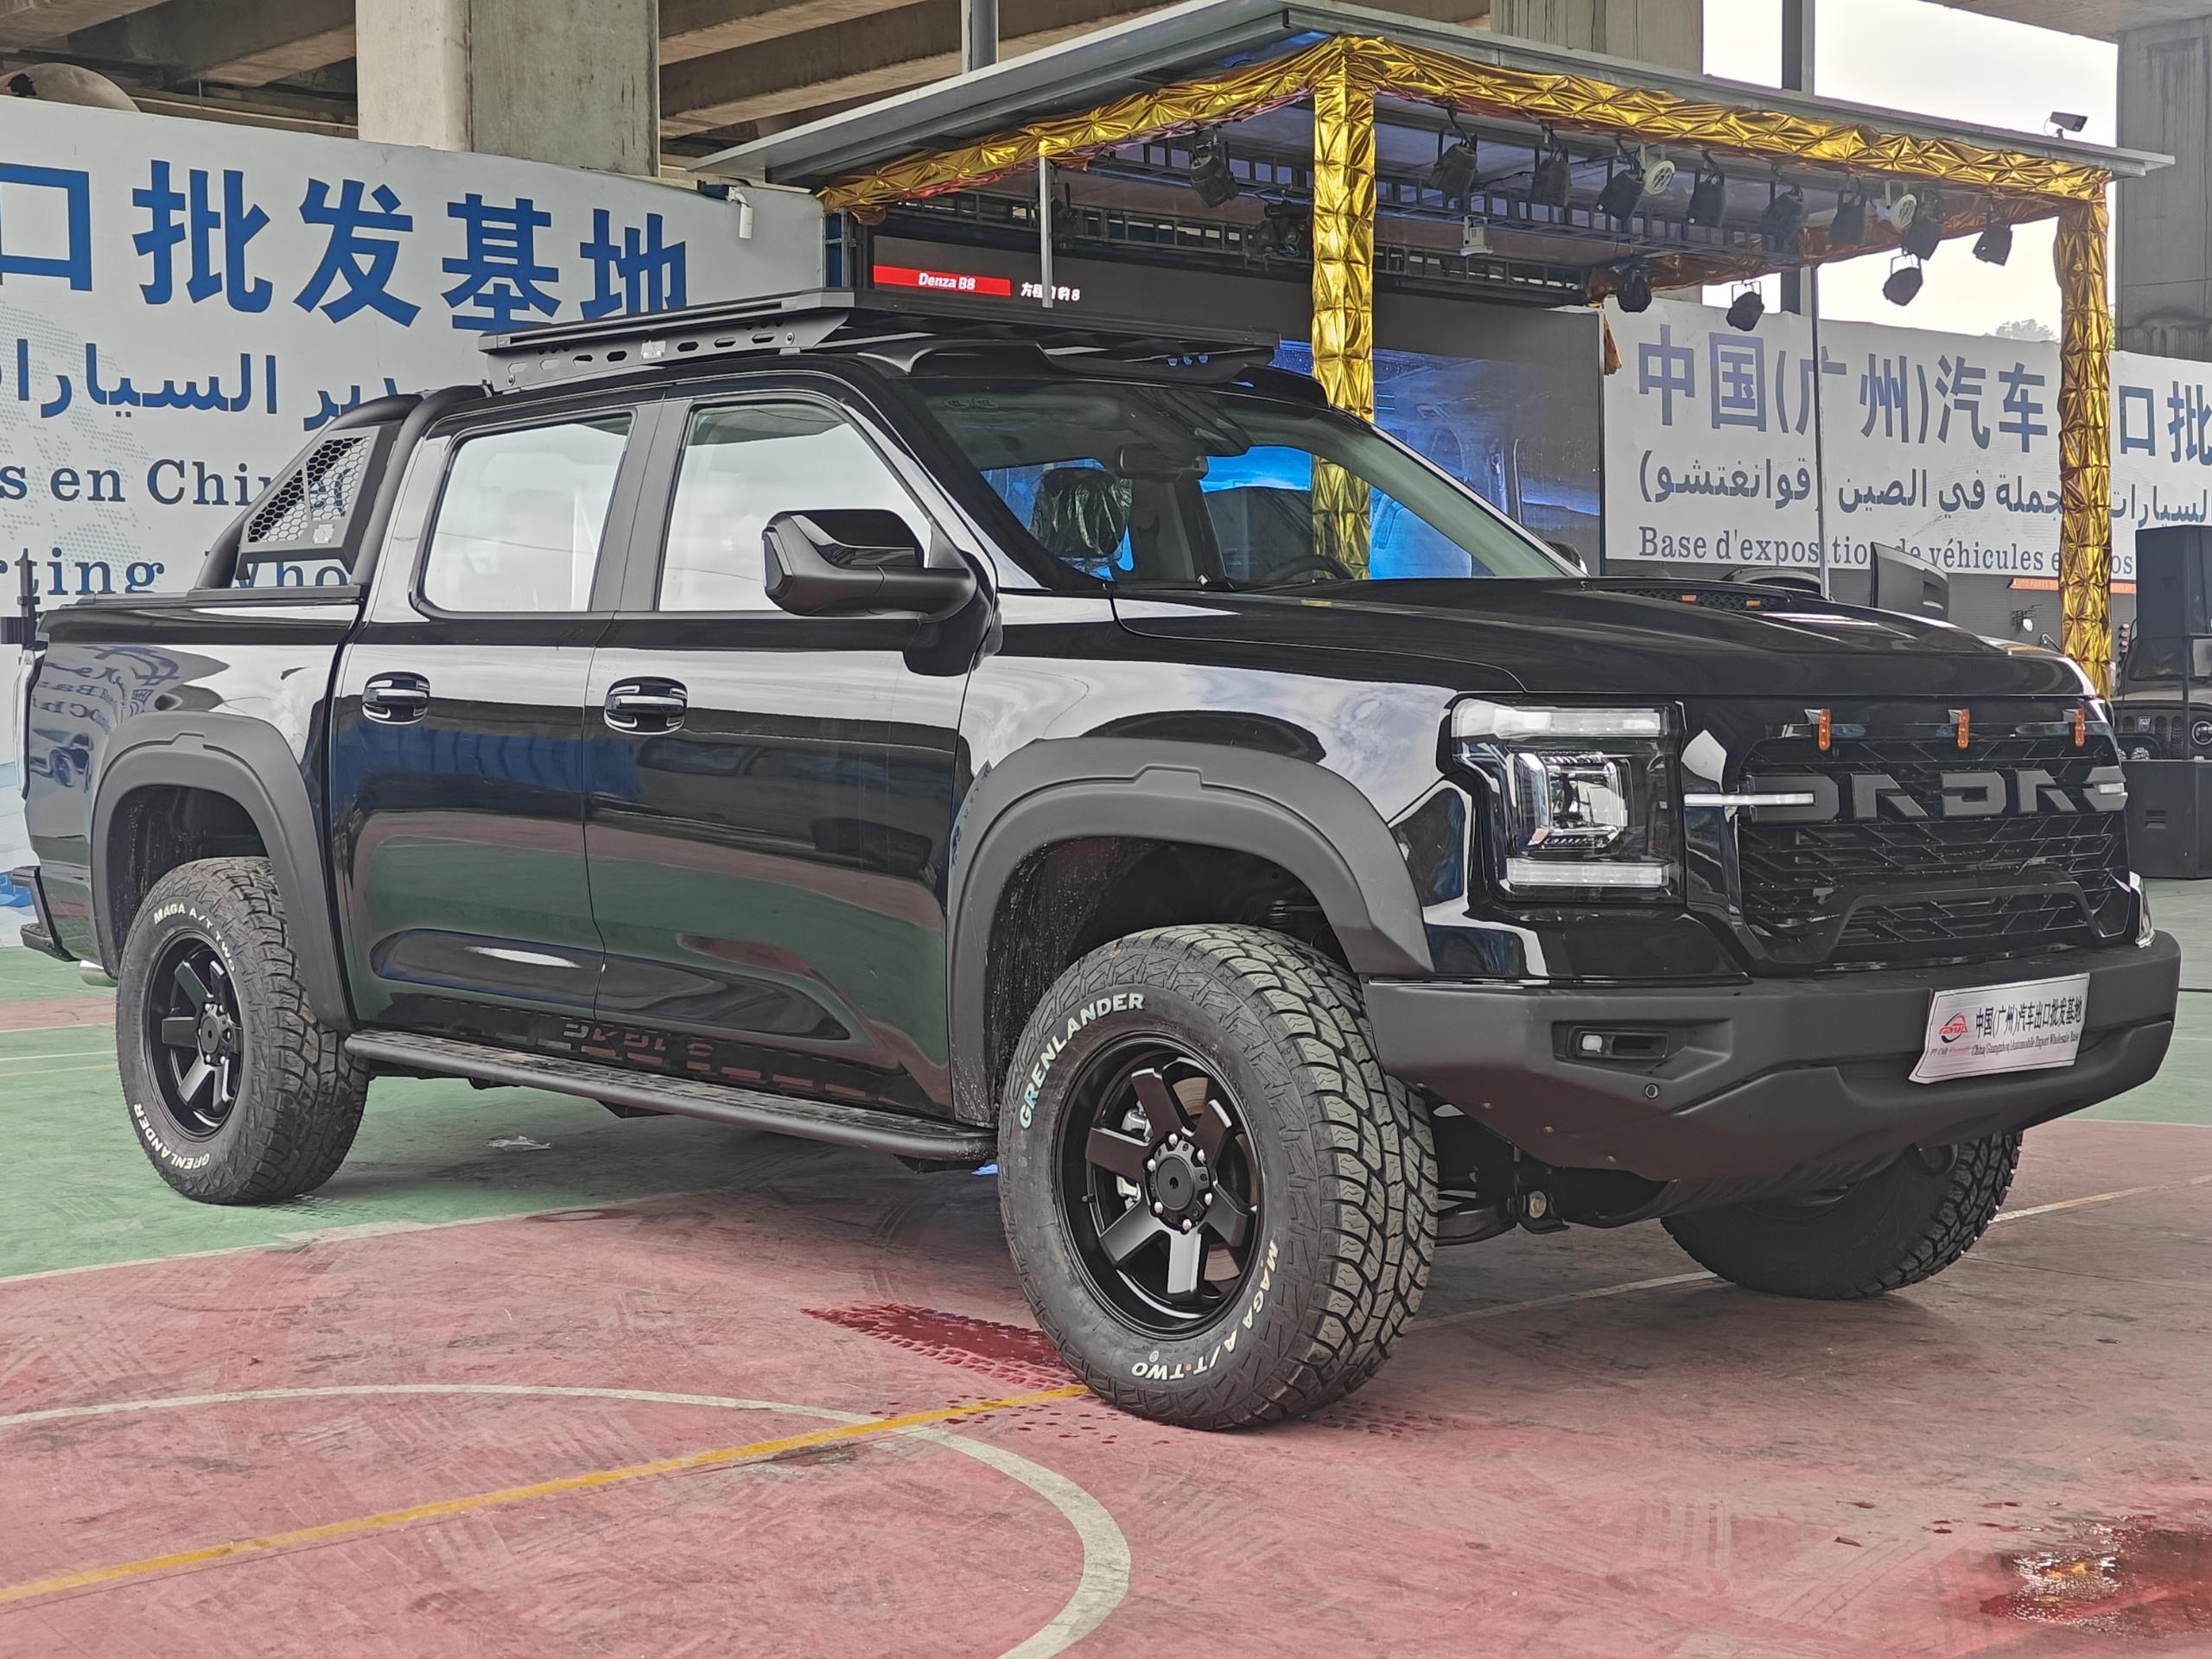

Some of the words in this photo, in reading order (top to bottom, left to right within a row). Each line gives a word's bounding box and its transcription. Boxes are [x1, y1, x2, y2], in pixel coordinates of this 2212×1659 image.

[918, 271, 956, 289] Denza
[958, 275, 976, 290] B8
[50, 467, 126, 502] en
[1838, 467, 1927, 512] الصين
[1938, 469, 1986, 518] في
[1638, 525, 1707, 560] Base
[1715, 528, 1869, 567] d'expostio
[1929, 537, 2044, 571] véhicules
[153, 902, 187, 925] MAGA
[188, 907, 214, 929] A/T
[215, 930, 235, 972] TWO
[1020, 993, 1145, 1129] GRENLANDER
[133, 1103, 211, 1170] GRENLANDER
[1242, 1239, 1279, 1330] MAGA
[1131, 1362, 1185, 1381] TWO
[1192, 1329, 1237, 1376] A/T
